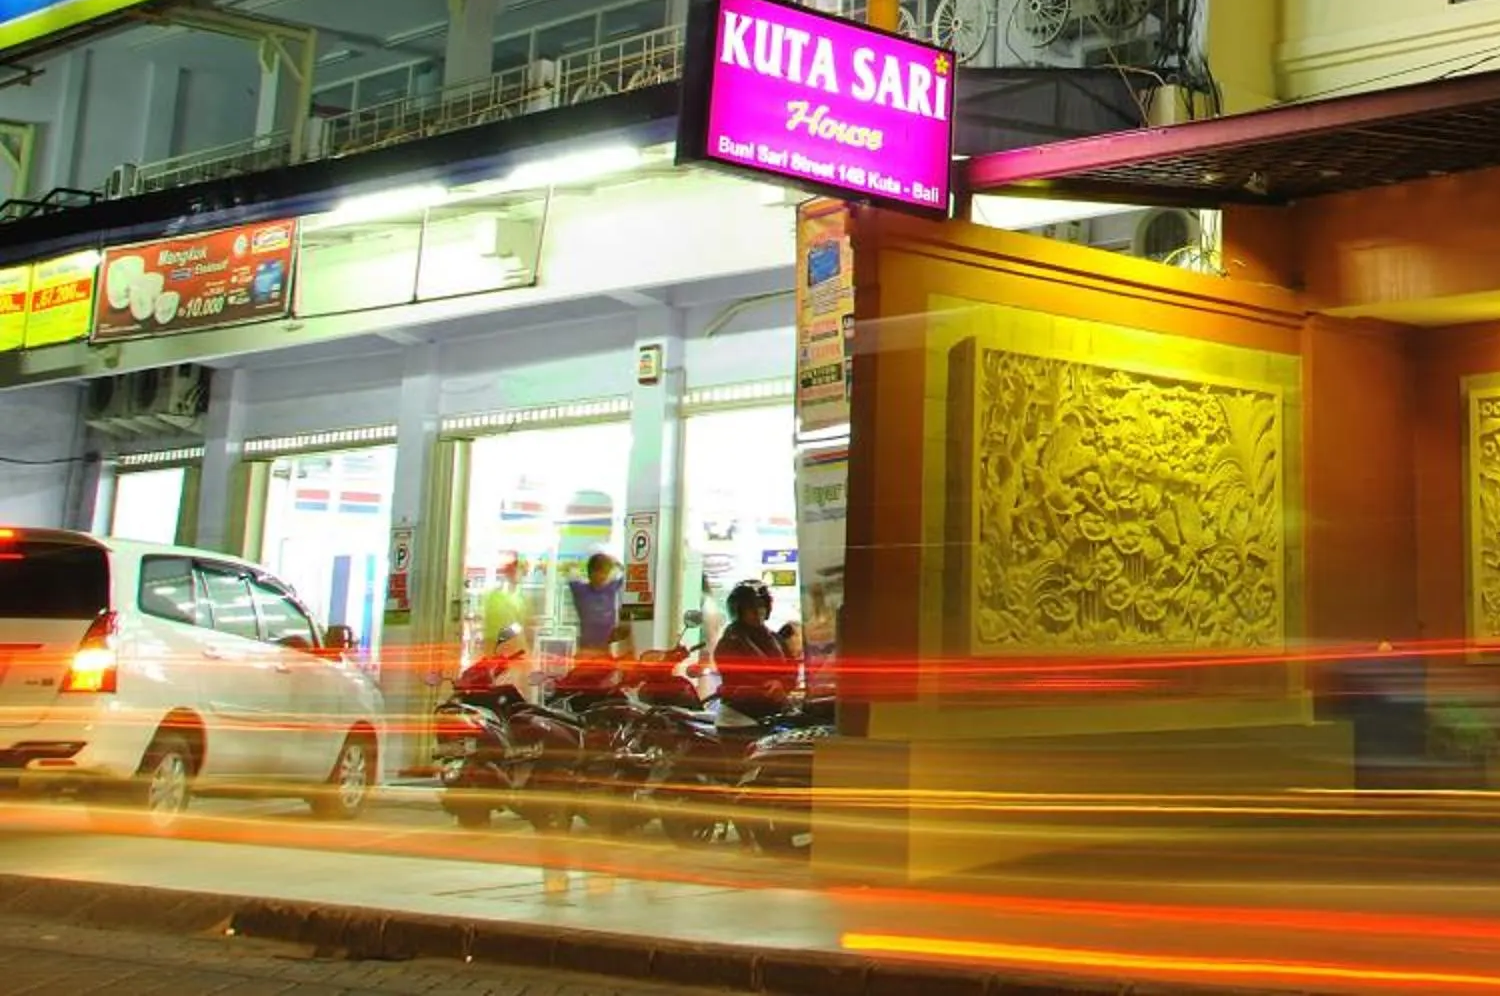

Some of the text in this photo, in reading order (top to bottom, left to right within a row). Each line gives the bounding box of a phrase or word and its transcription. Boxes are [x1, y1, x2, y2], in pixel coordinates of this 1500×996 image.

[720, 11, 839, 93] KUTA
[785, 100, 884, 151] House
[757, 144, 788, 168] Sari
[867, 170, 901, 194] Kuta
[912, 180, 940, 203] Bali
